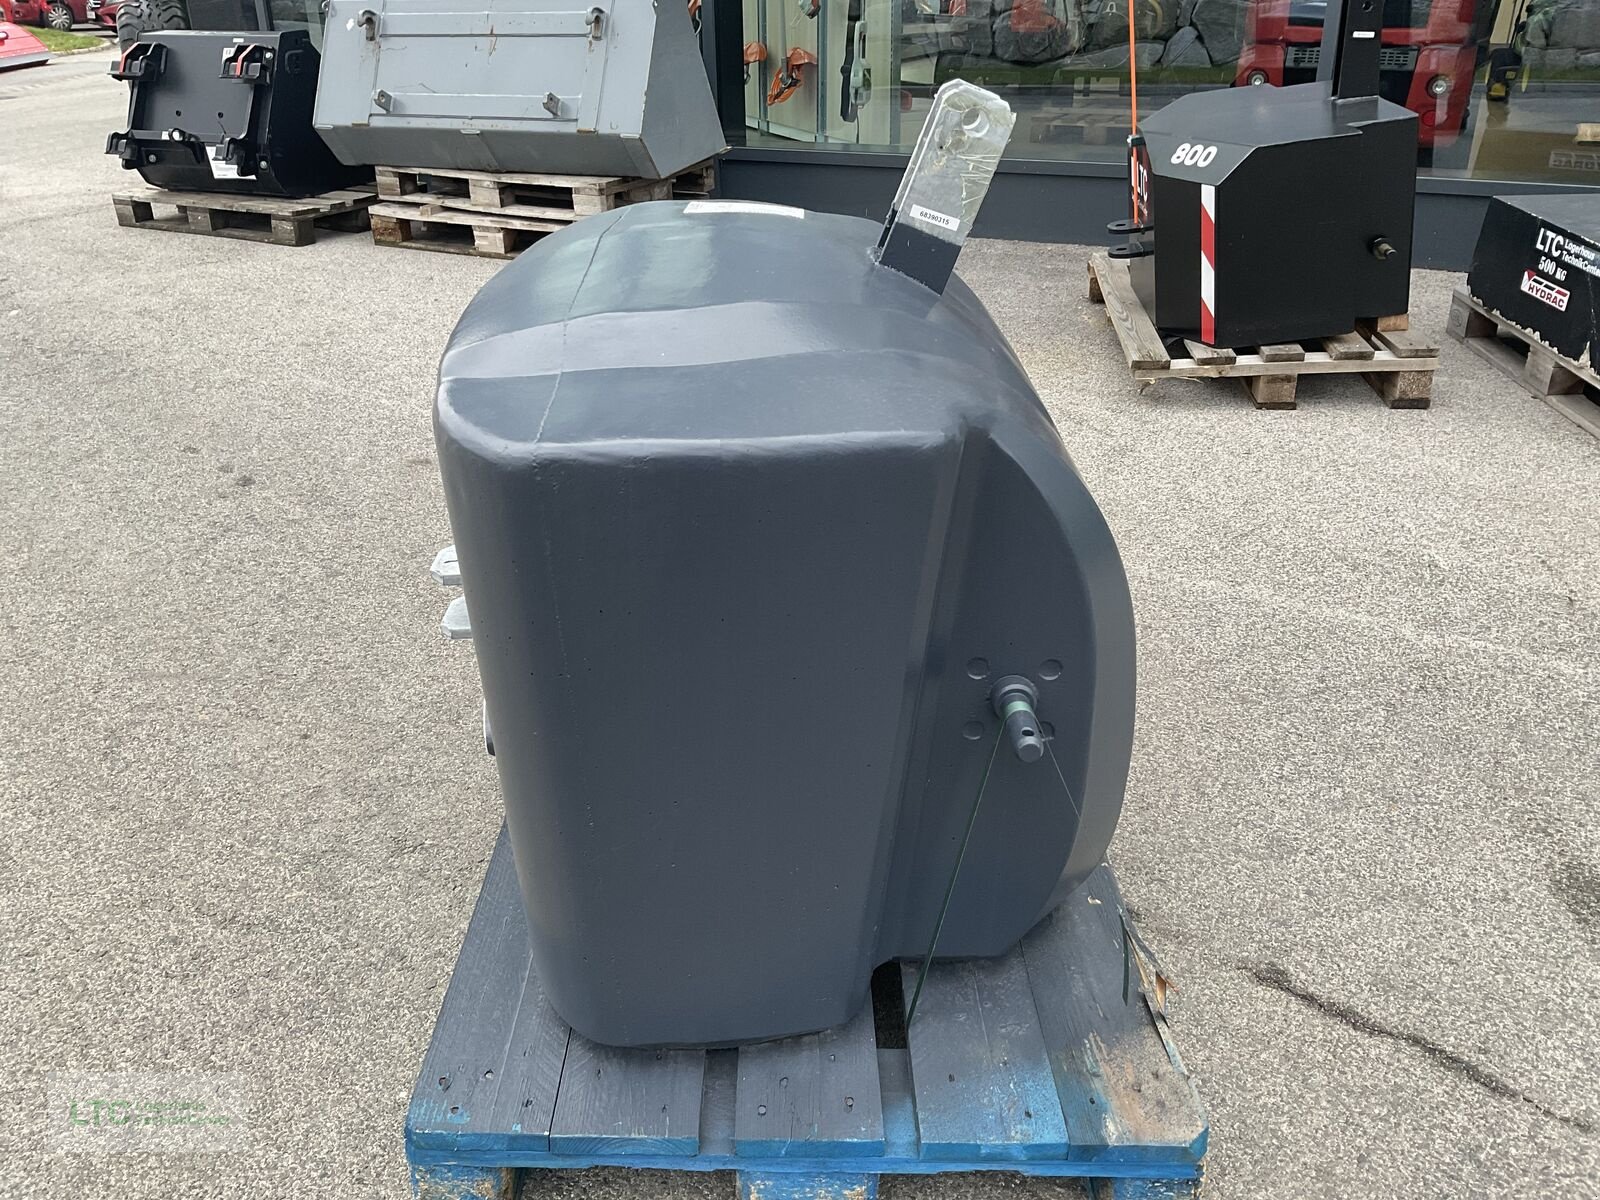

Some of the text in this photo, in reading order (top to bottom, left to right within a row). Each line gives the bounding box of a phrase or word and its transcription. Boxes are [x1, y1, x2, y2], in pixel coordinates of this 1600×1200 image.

[1171, 143, 1217, 167] 800
[920, 211, 950, 225] 68390315
[1536, 227, 1564, 257] LTC
[1538, 256, 1567, 281] 500 KG
[1528, 283, 1565, 308] HYDRAC
